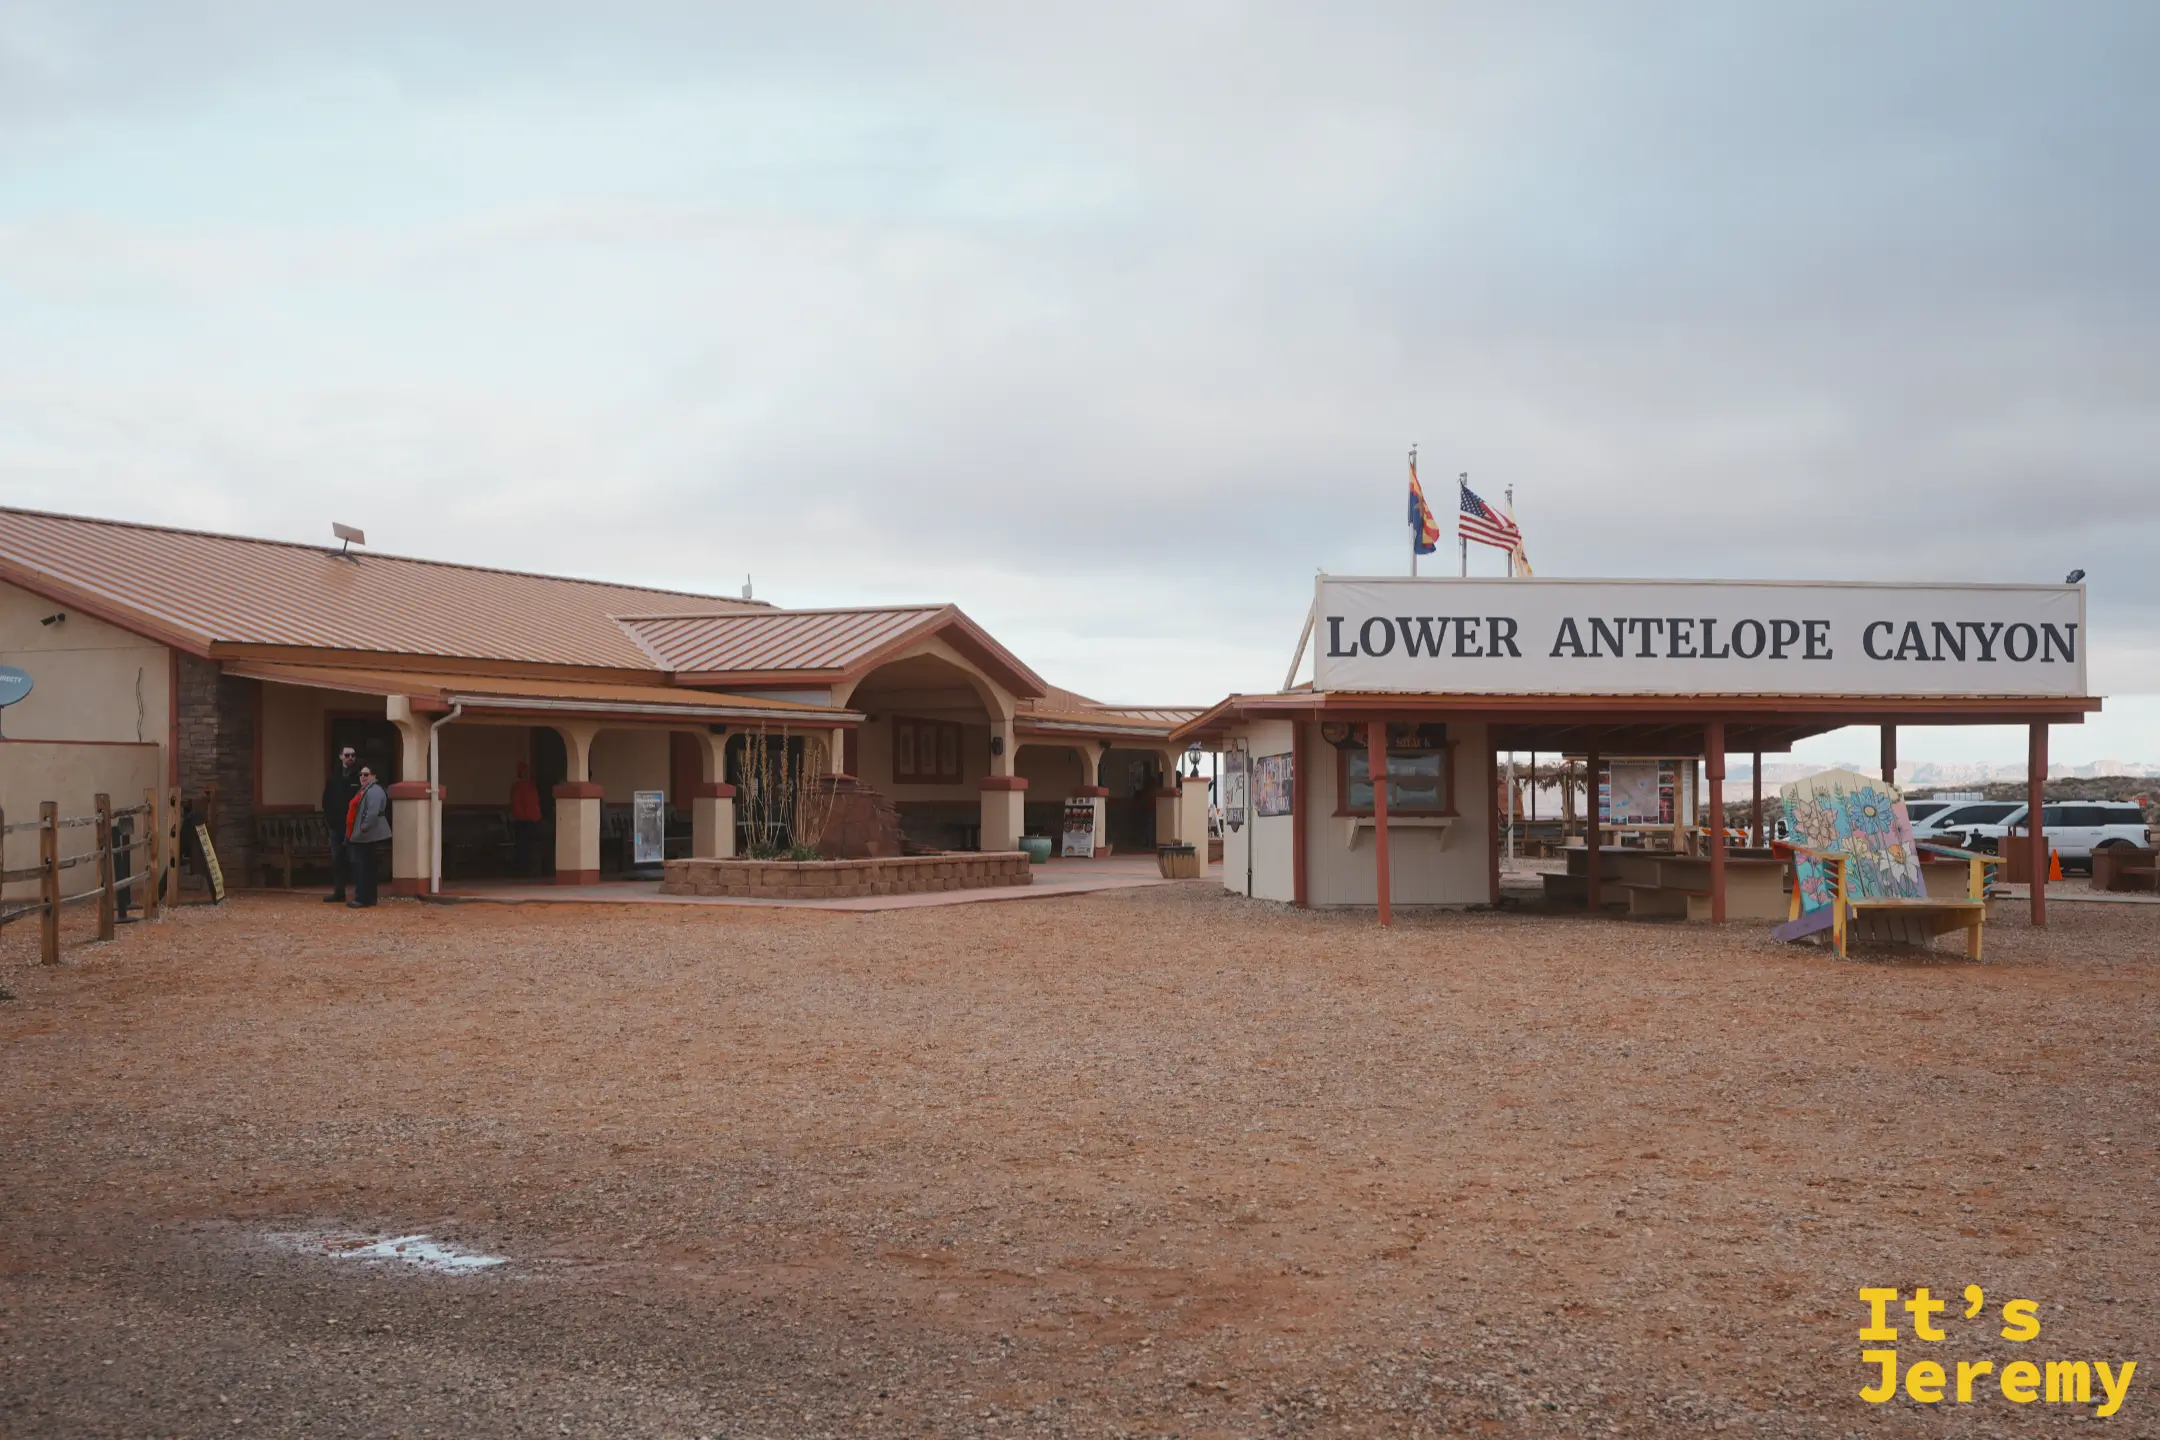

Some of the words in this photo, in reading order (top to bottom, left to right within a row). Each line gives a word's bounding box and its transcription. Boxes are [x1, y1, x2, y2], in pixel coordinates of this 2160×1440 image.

[1327, 616, 1522, 658] LOWER
[1549, 617, 1833, 660] ANTELOPE
[1862, 620, 2079, 663] CANYON
